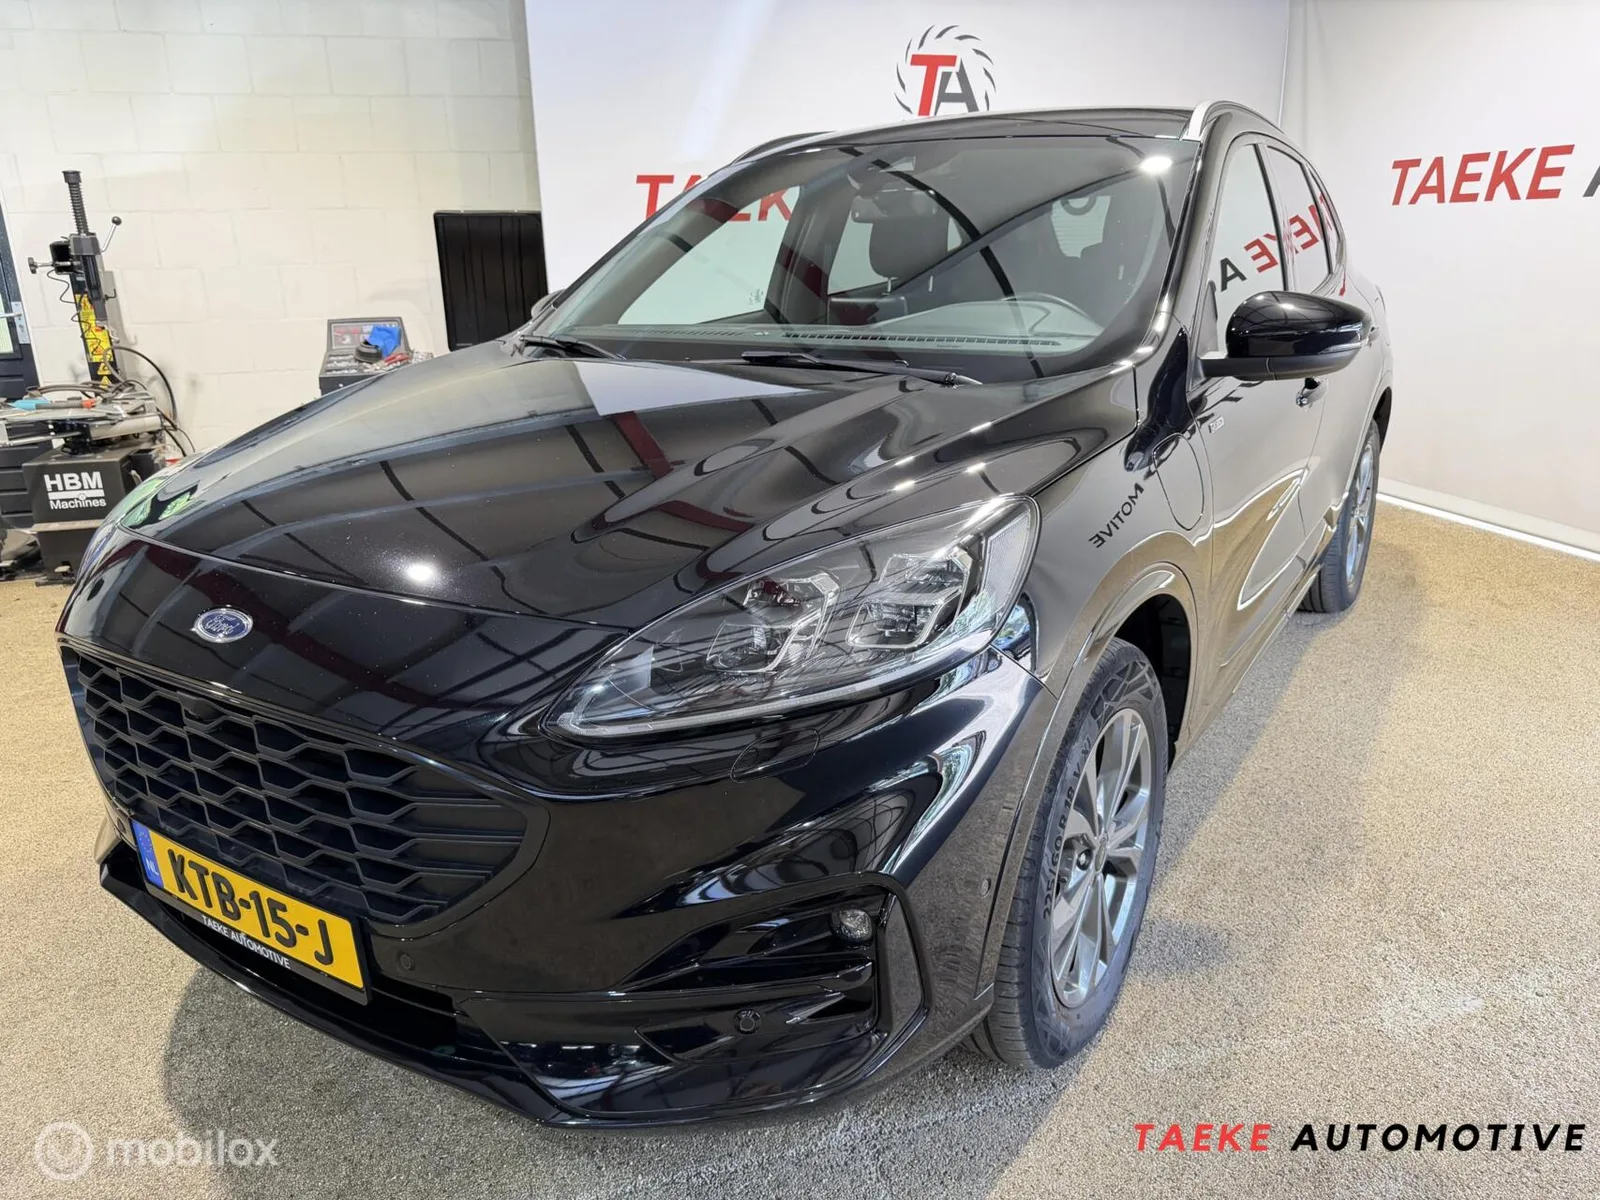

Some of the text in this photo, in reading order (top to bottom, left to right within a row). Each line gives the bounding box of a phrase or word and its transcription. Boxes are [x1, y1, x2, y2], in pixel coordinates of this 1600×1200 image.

[910, 54, 979, 117] TA
[1391, 144, 1575, 206] TAEKE
[44, 471, 103, 491] HBM
[49, 498, 106, 510] Machines
[168, 848, 334, 966] KTB-15-J
[202, 914, 292, 970] TAEKE AUTOMOTIVE
